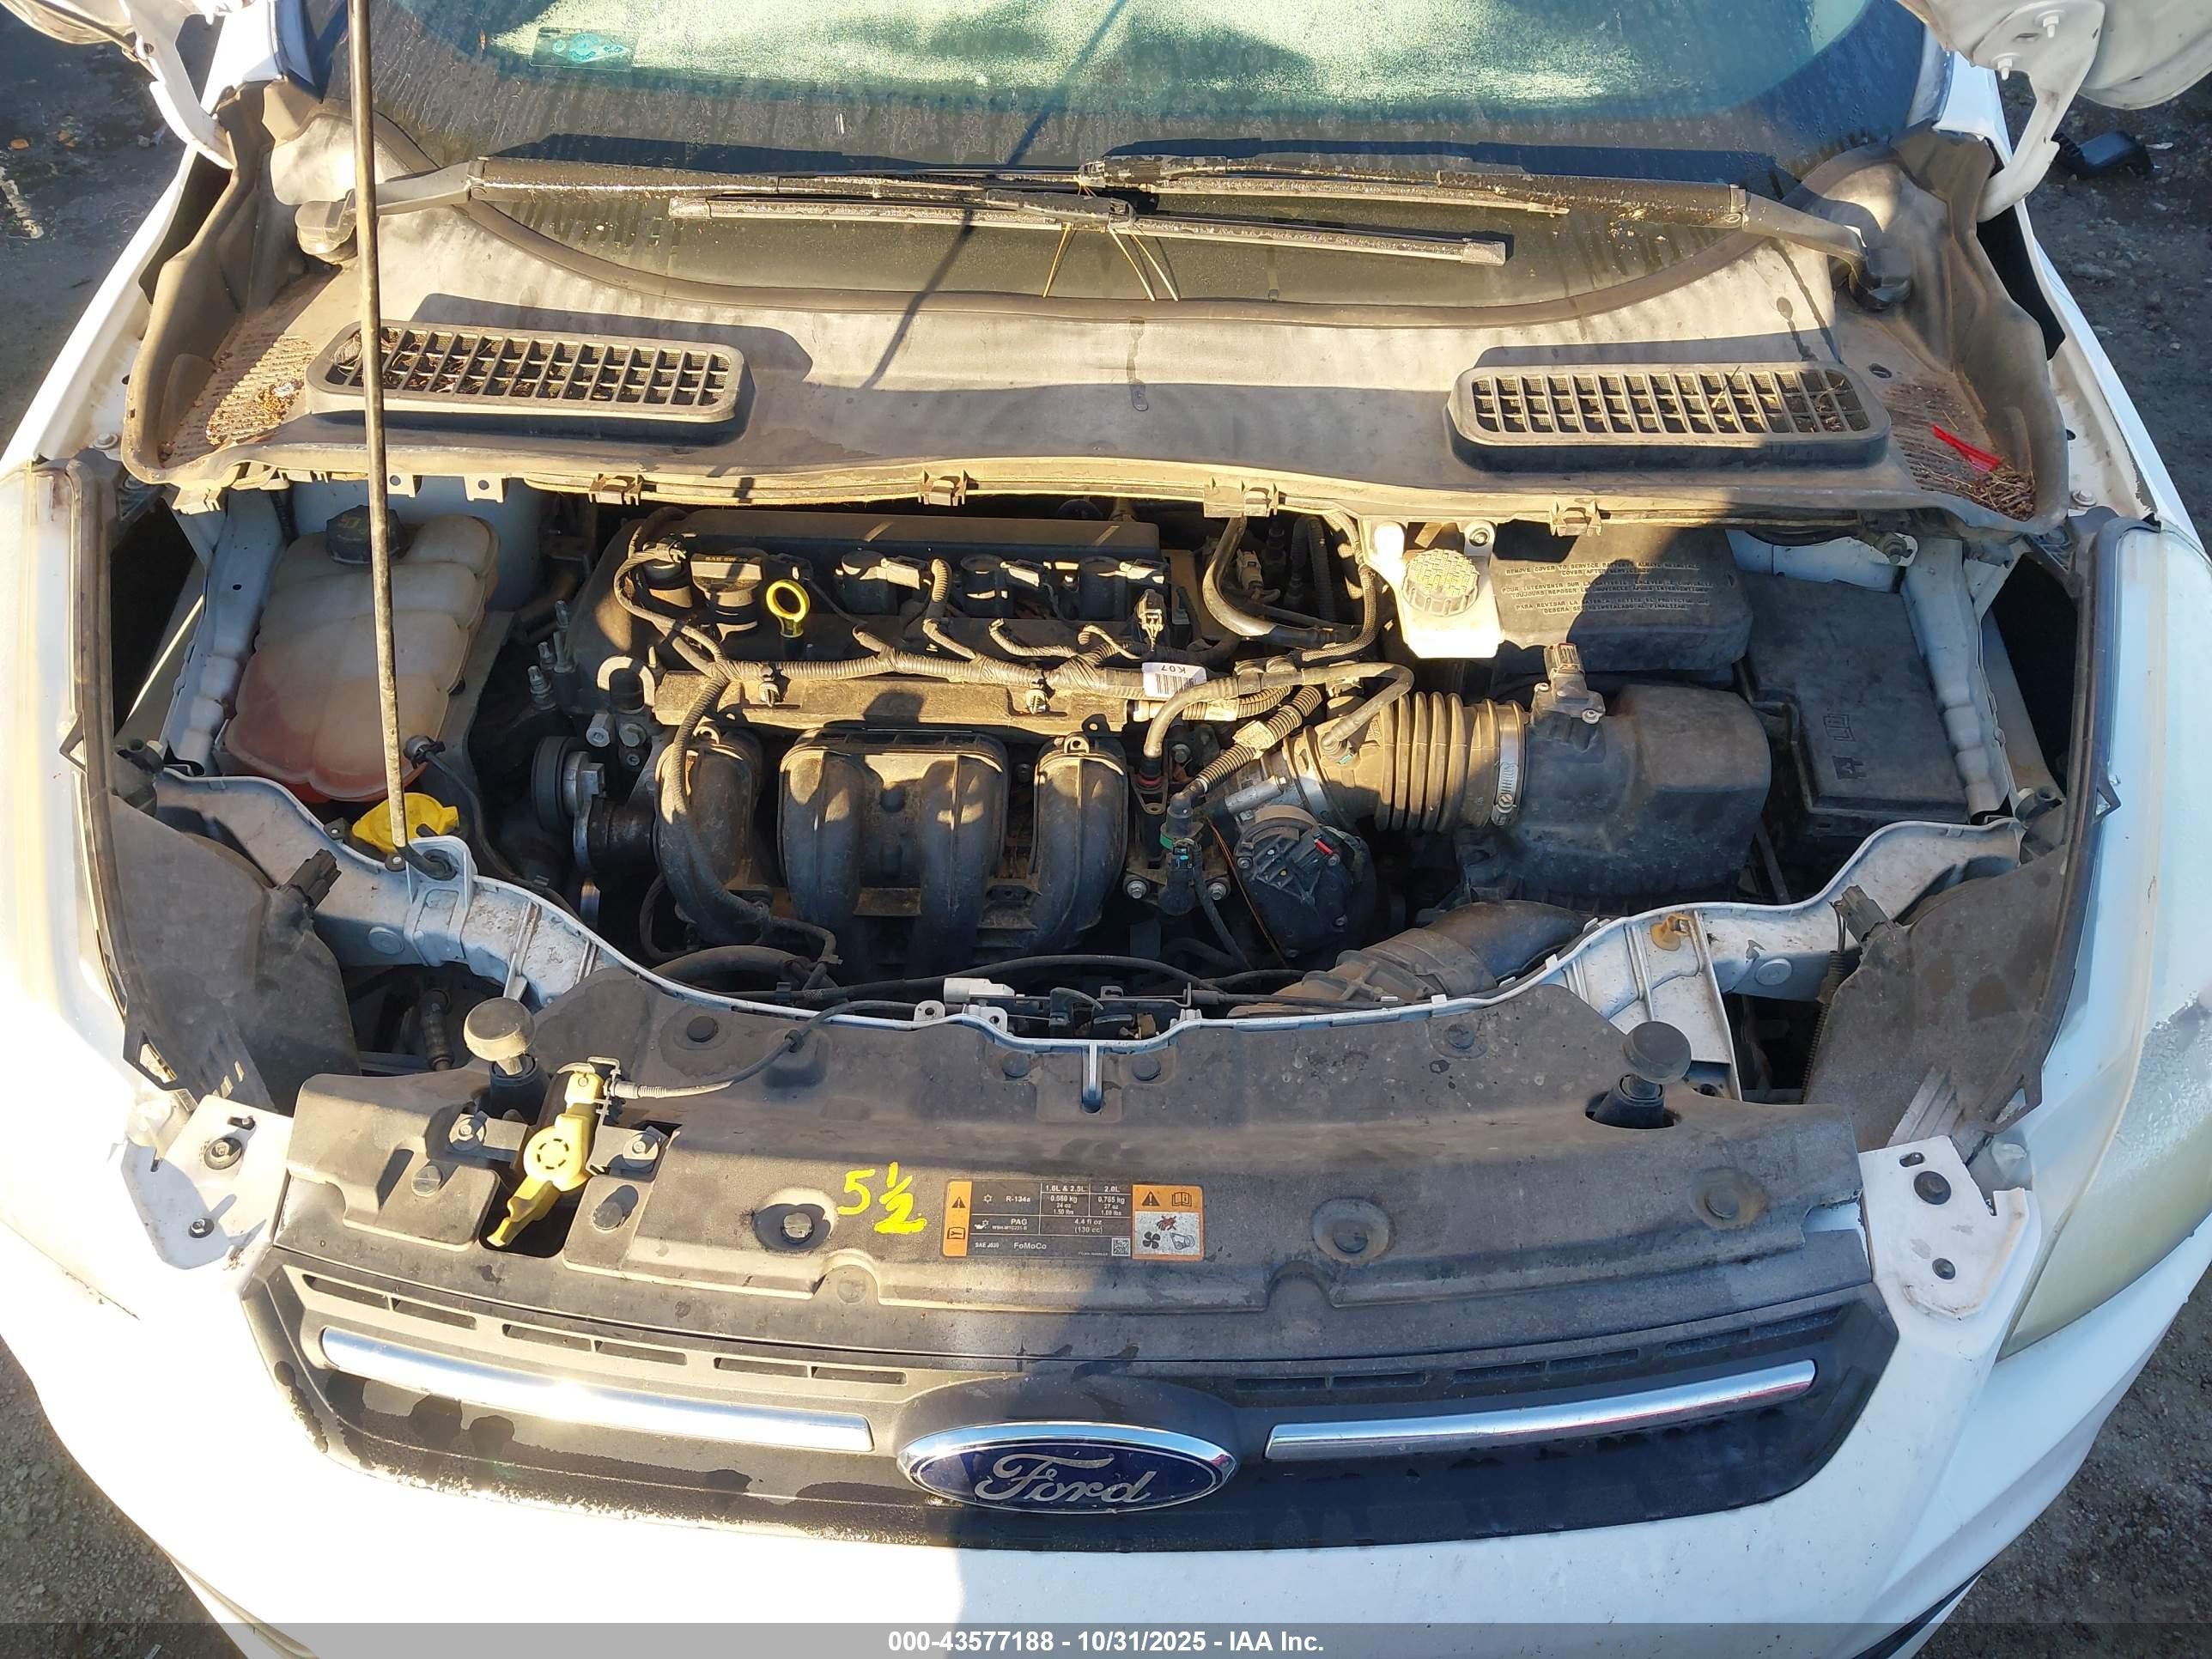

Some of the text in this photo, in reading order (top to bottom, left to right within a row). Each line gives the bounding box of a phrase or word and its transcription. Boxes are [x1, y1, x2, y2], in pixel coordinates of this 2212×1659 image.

[1070, 1194, 1078, 1203] kg
[1117, 1195, 1125, 1204] kg
[1013, 1242, 1047, 1250] FoMoCo
[974, 1453, 1157, 1504] Ford
